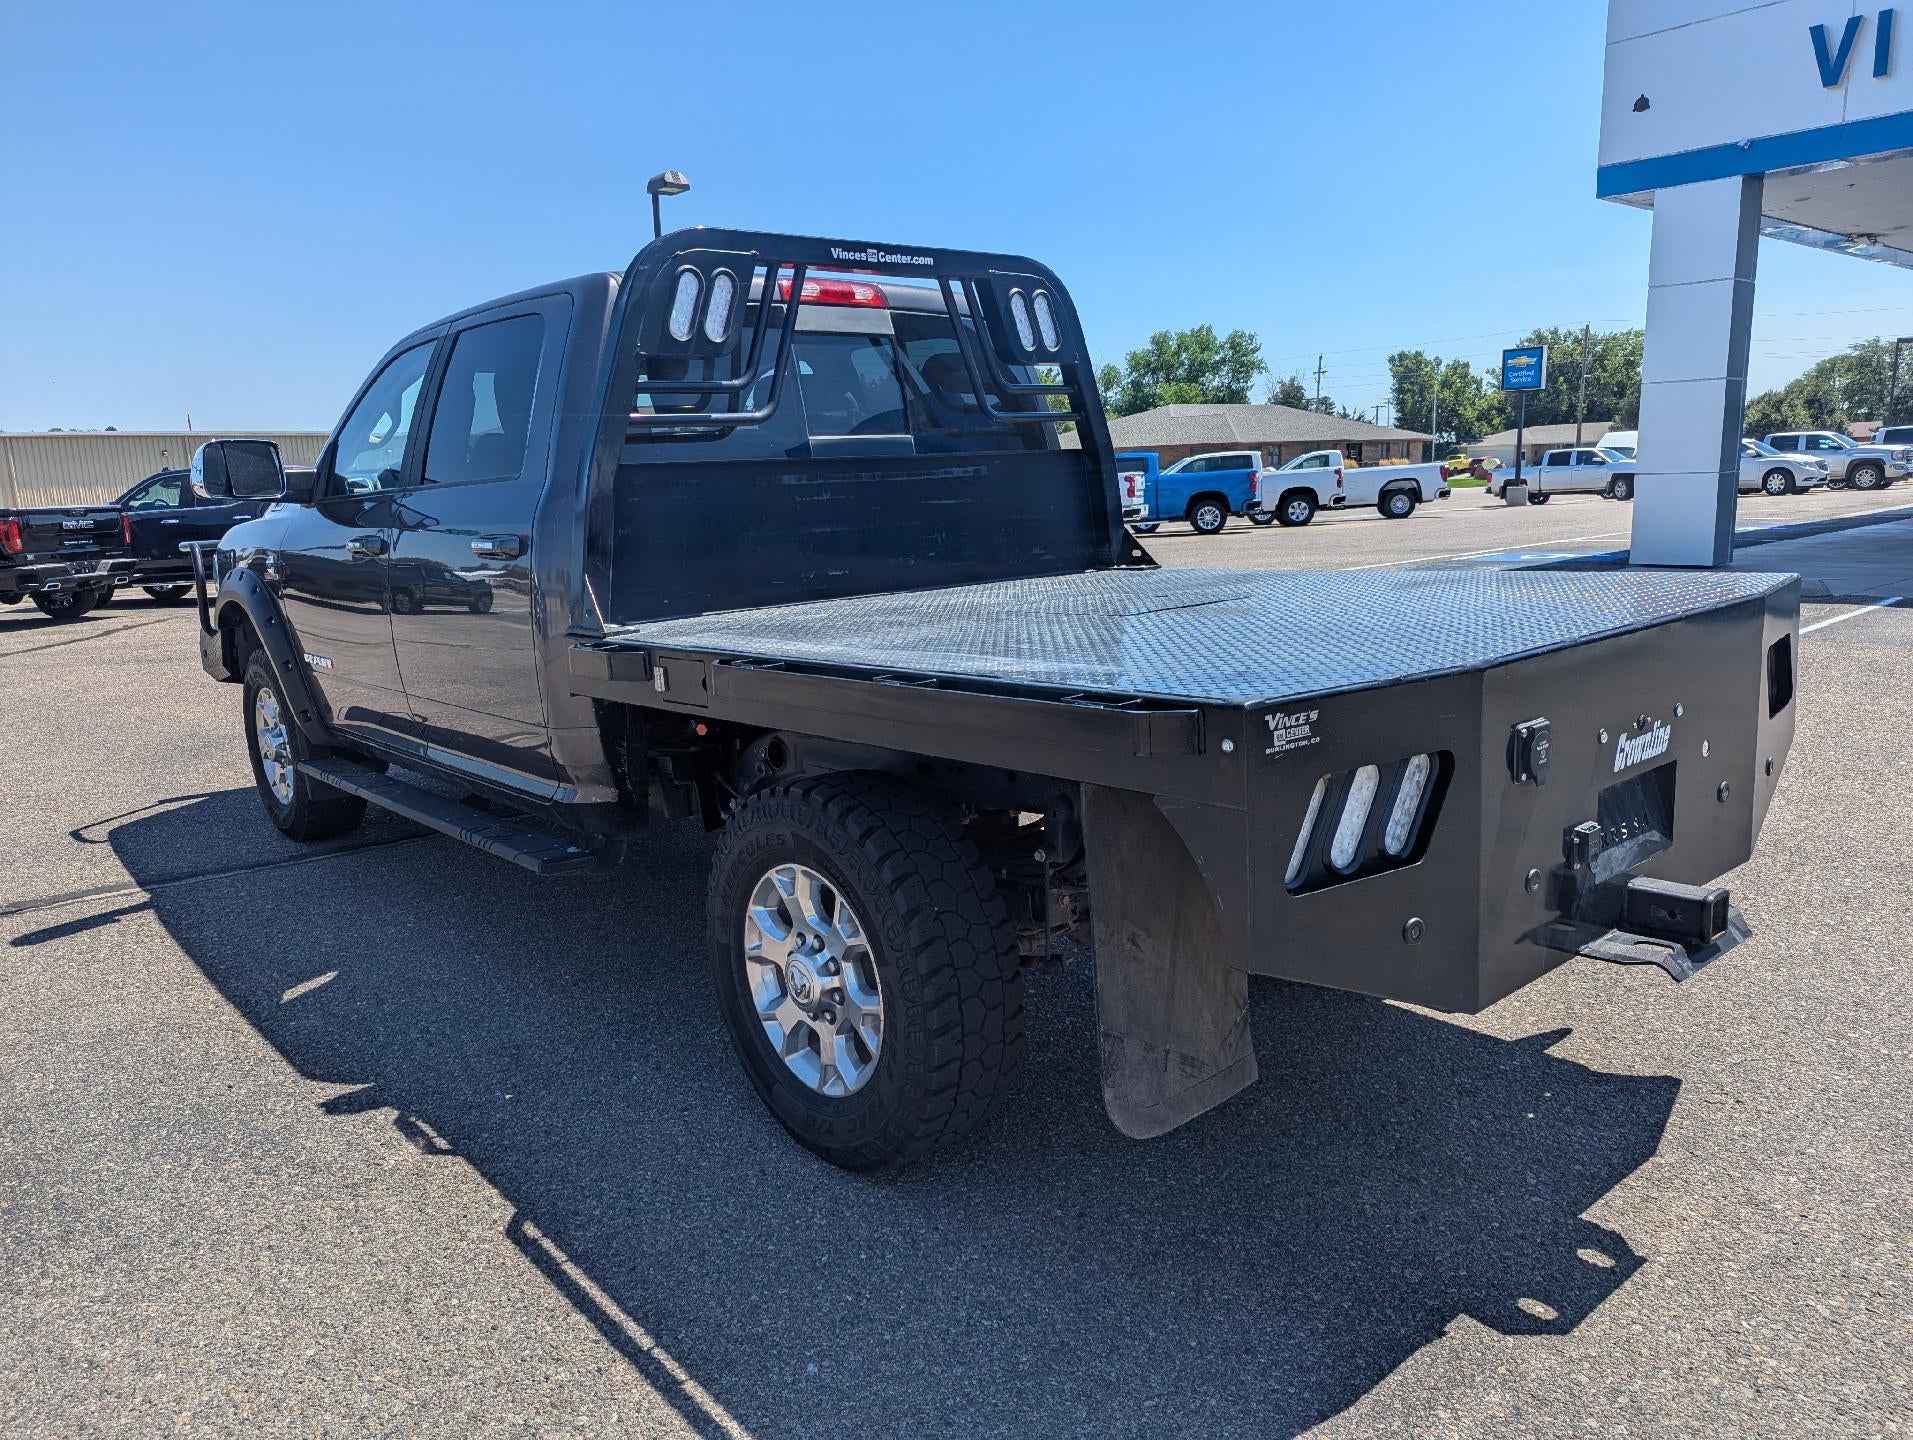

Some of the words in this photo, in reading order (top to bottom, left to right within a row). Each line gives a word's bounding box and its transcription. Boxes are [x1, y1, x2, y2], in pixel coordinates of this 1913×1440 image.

[1808, 8, 1896, 88] VI
[831, 247, 867, 261] Vinces
[878, 251, 934, 266] Center.com
[1508, 370, 1535, 378] Certified
[1510, 376, 1532, 384] Service
[1286, 725, 1310, 738] CENTER
[1310, 736, 1321, 744] CO
[1613, 719, 1671, 773] Crownline
